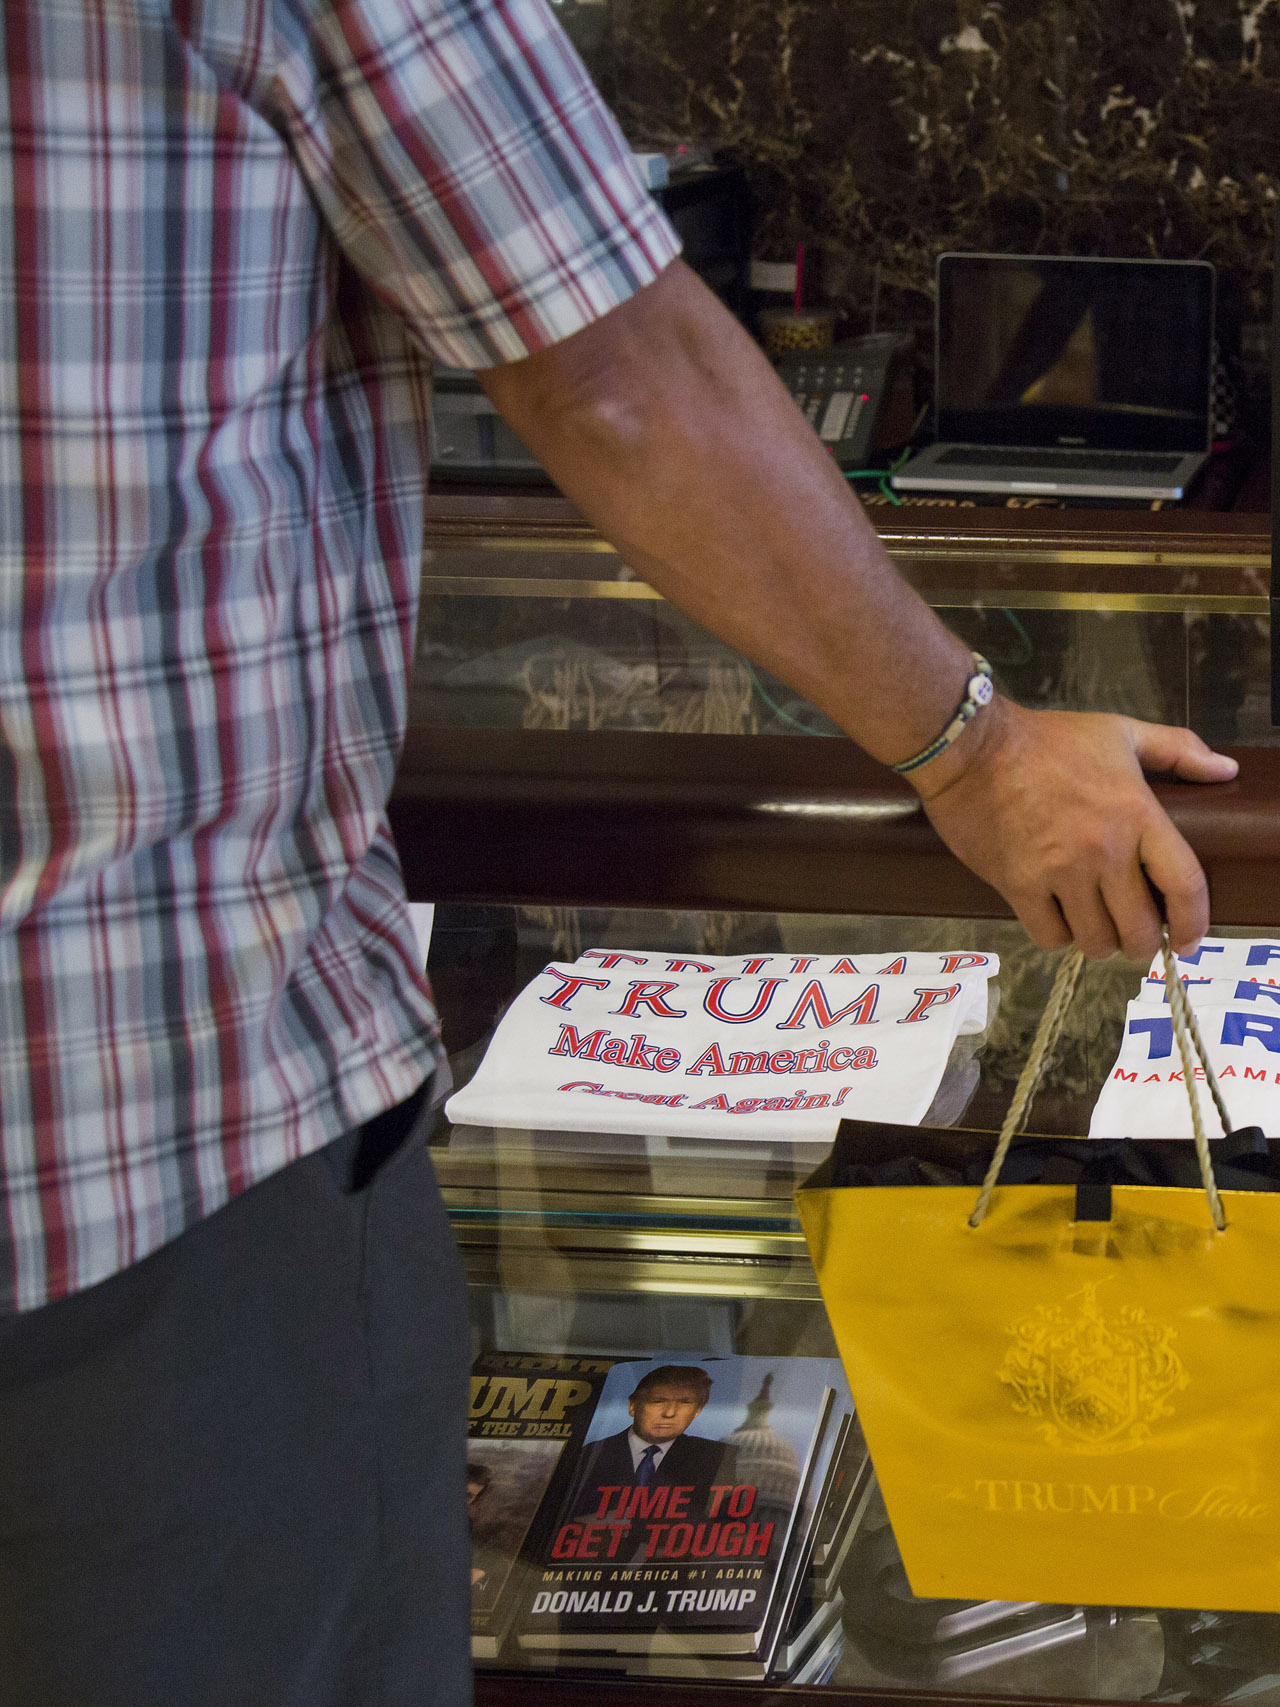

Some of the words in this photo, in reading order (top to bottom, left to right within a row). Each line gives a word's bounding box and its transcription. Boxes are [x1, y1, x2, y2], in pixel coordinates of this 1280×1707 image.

[539, 965, 962, 1031] TRUMP
[548, 1022, 681, 1074] Make
[685, 1039, 879, 1077] America
[1114, 1066, 1206, 1083] MAKE
[688, 1086, 853, 1115] Again!
[482, 1420, 523, 1436] THE
[522, 1421, 573, 1437] DEAL
[596, 1484, 695, 1520] TIME
[708, 1484, 757, 1519] TO
[973, 1478, 1156, 1515] TRUMP
[1158, 1483, 1271, 1520] Store
[551, 1522, 632, 1559] GET
[645, 1521, 775, 1558] TOUGH
[542, 1570, 603, 1582] MAKING
[610, 1569, 679, 1581] AMERICA
[687, 1569, 707, 1580] #1
[715, 1568, 763, 1580] AGAIN
[531, 1590, 634, 1614] DONALD
[637, 1590, 659, 1613] J.
[665, 1588, 757, 1612] TRUMP
